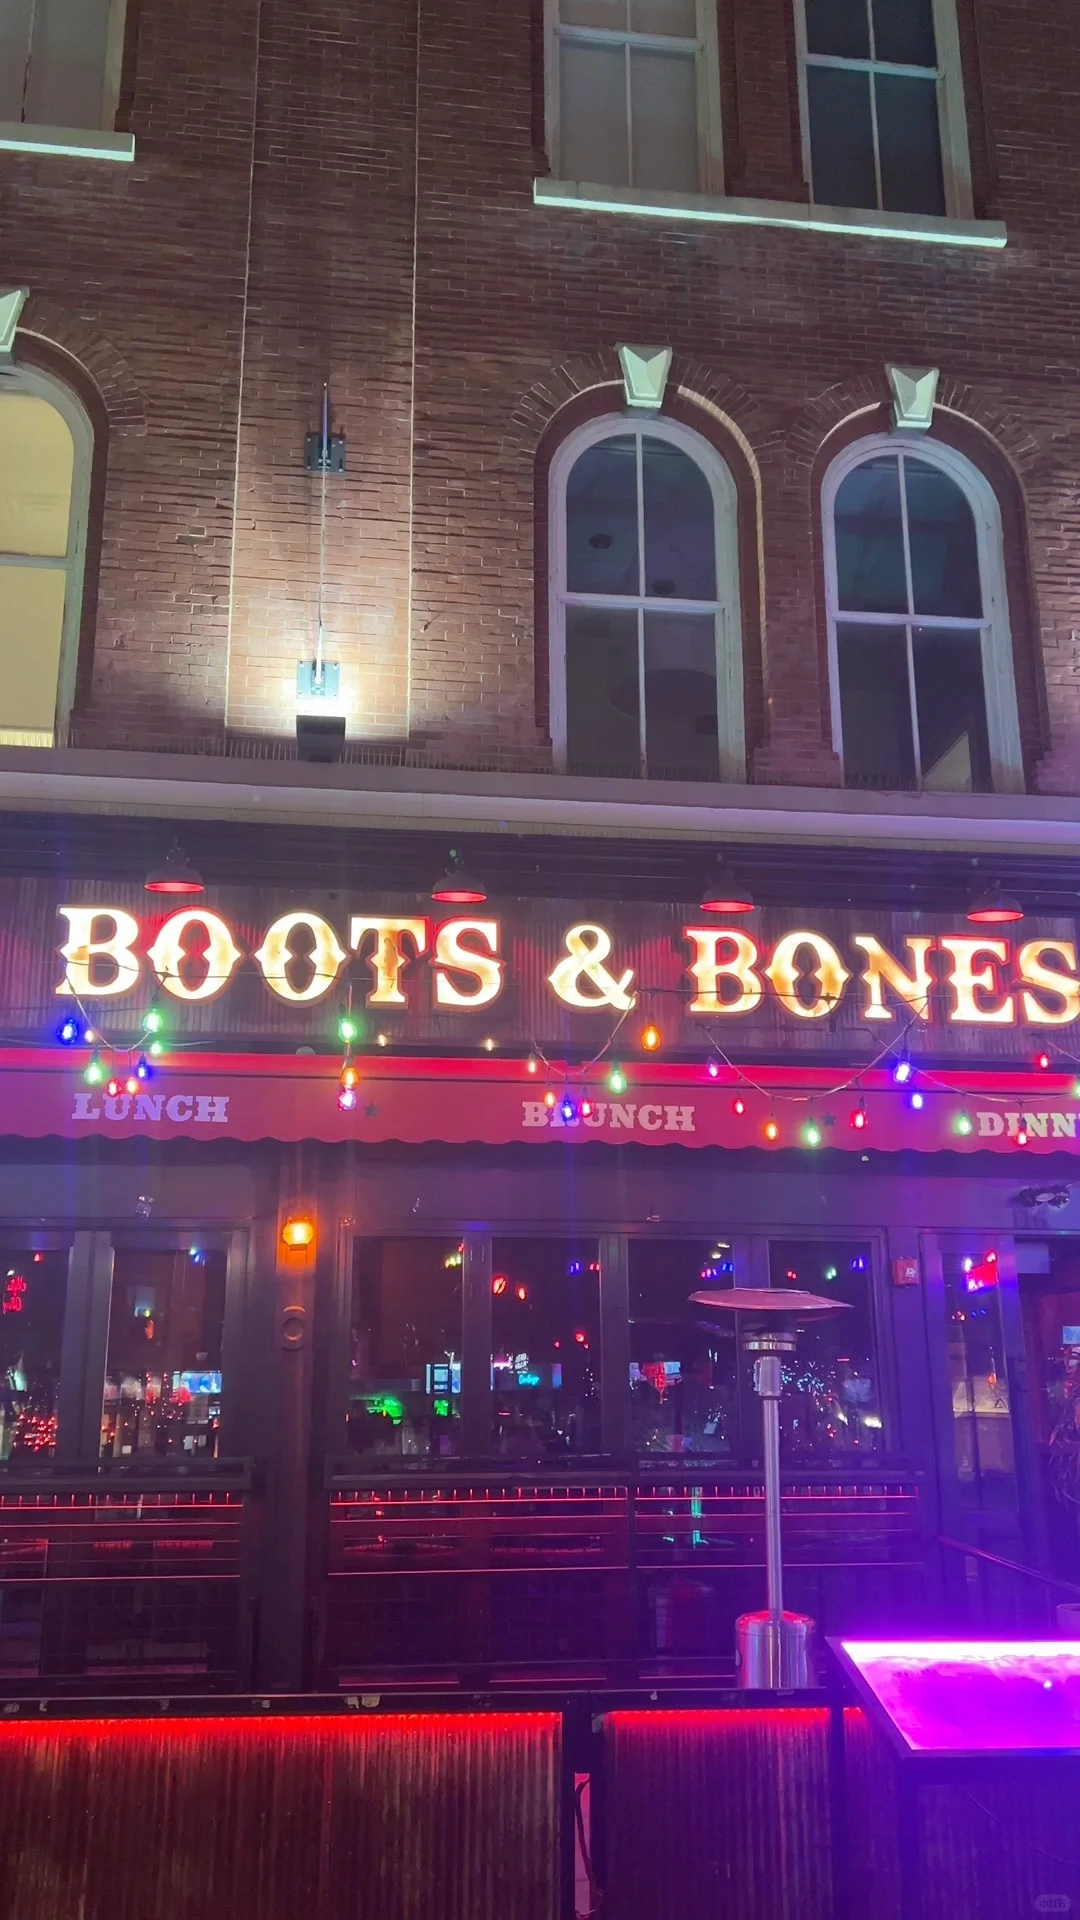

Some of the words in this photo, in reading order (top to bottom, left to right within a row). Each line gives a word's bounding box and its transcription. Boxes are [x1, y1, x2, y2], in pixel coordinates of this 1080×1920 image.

[55, 905, 506, 1008] BOOTS
[548, 922, 637, 1011] &
[683, 926, 1080, 1027] BONES
[71, 1093, 230, 1123] LUNCH
[976, 1111, 1080, 1138] DINN
